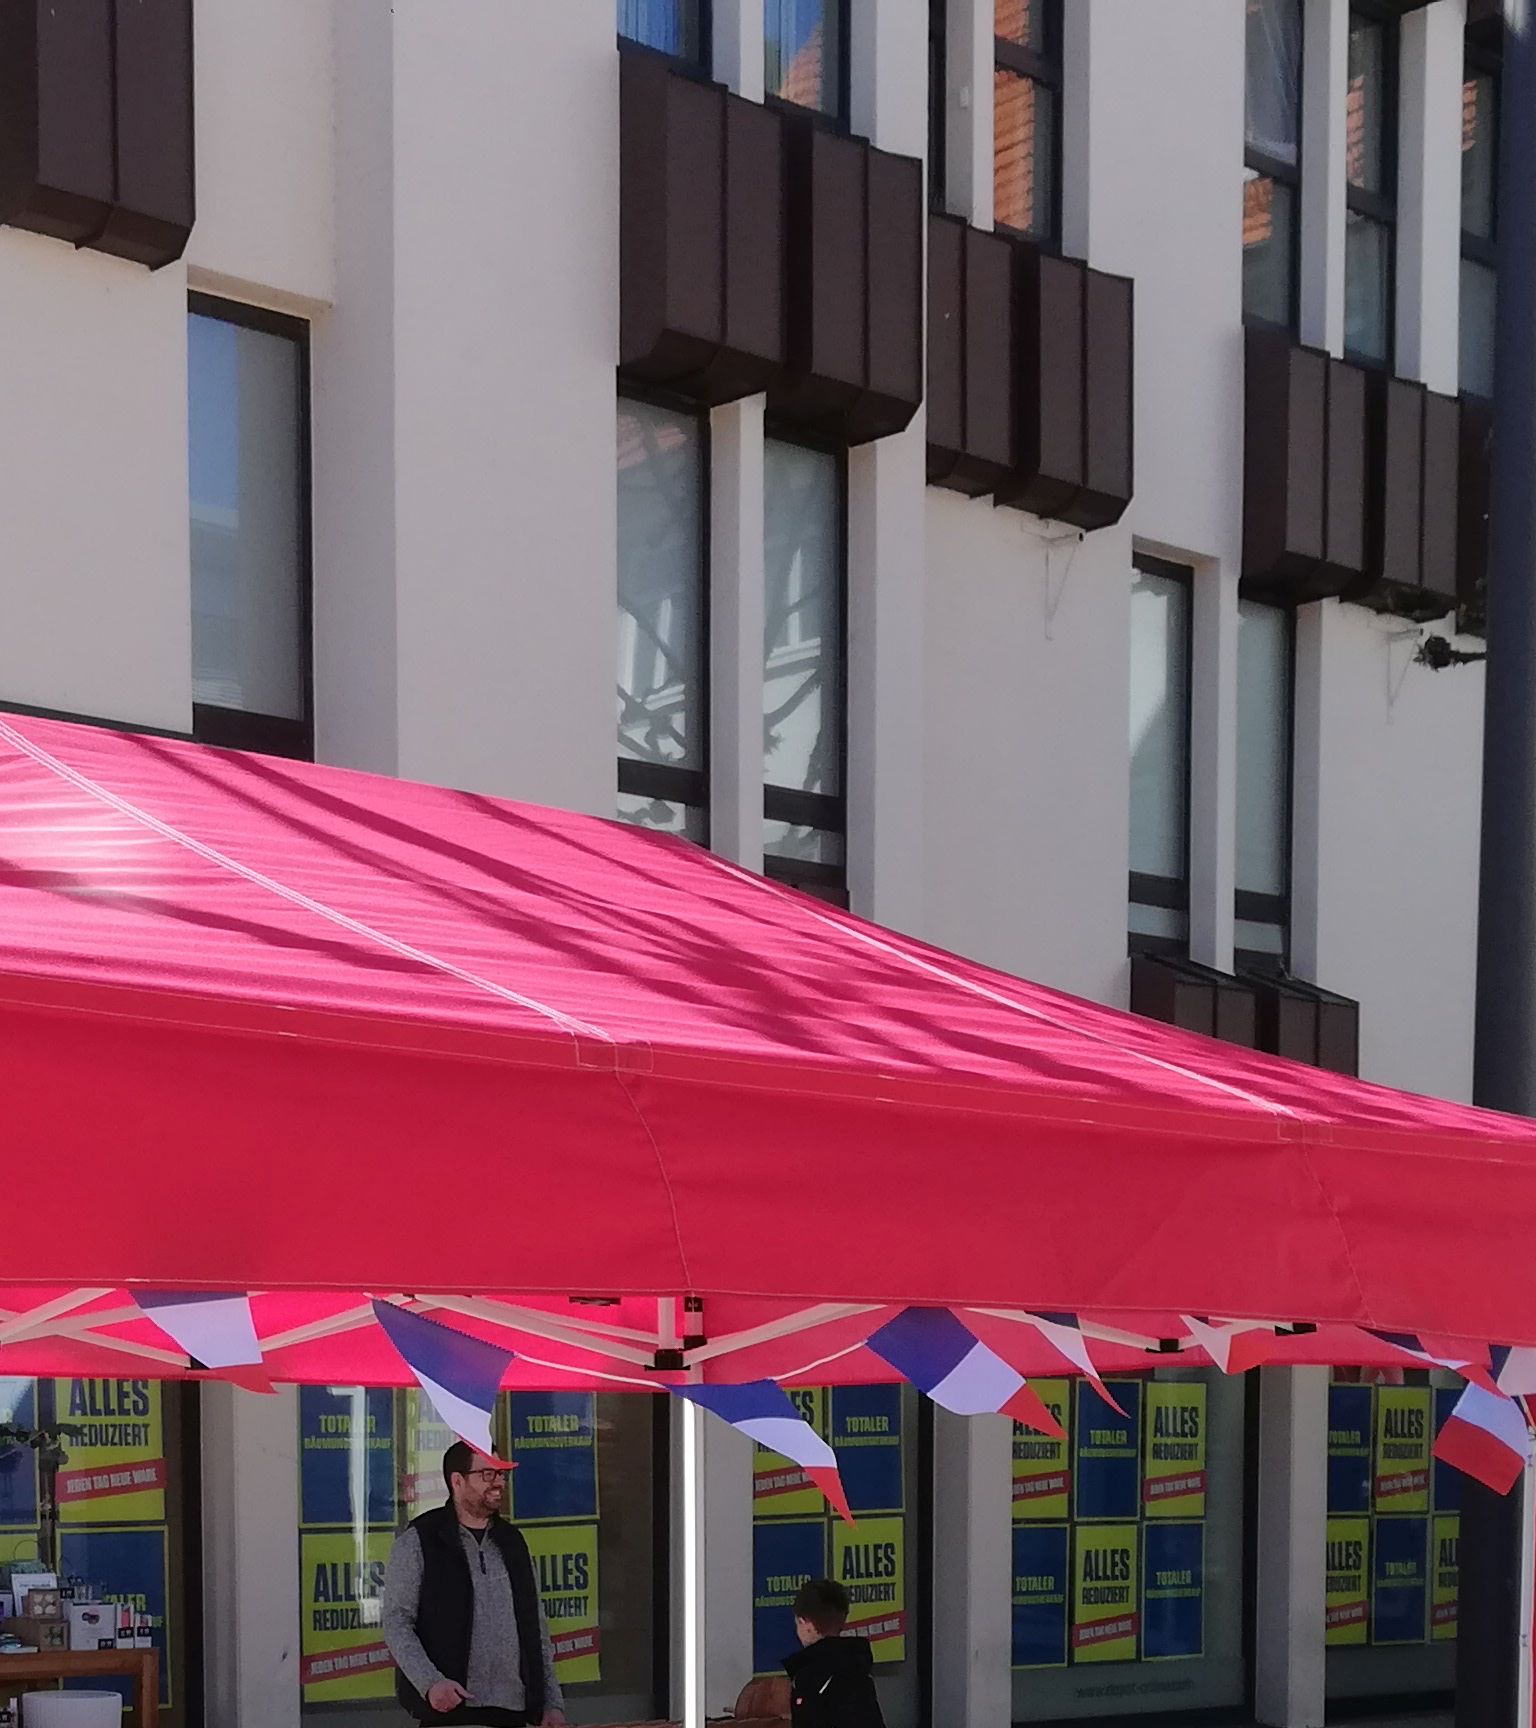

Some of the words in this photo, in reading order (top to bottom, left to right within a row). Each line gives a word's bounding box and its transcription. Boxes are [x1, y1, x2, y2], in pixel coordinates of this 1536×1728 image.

[69, 1379, 149, 1417] ALLES
[527, 1415, 580, 1433] TOTALER
[846, 1416, 889, 1432] TOTALER
[1154, 1406, 1199, 1438] ALLES
[1385, 1408, 1424, 1439] ALLES
[532, 1552, 589, 1593] LLES
[842, 1542, 896, 1580] ALLES
[1083, 1549, 1130, 1582] ALLES
[849, 1582, 896, 1603] EDUZIERT
[1016, 1576, 1054, 1591] TOTALER
